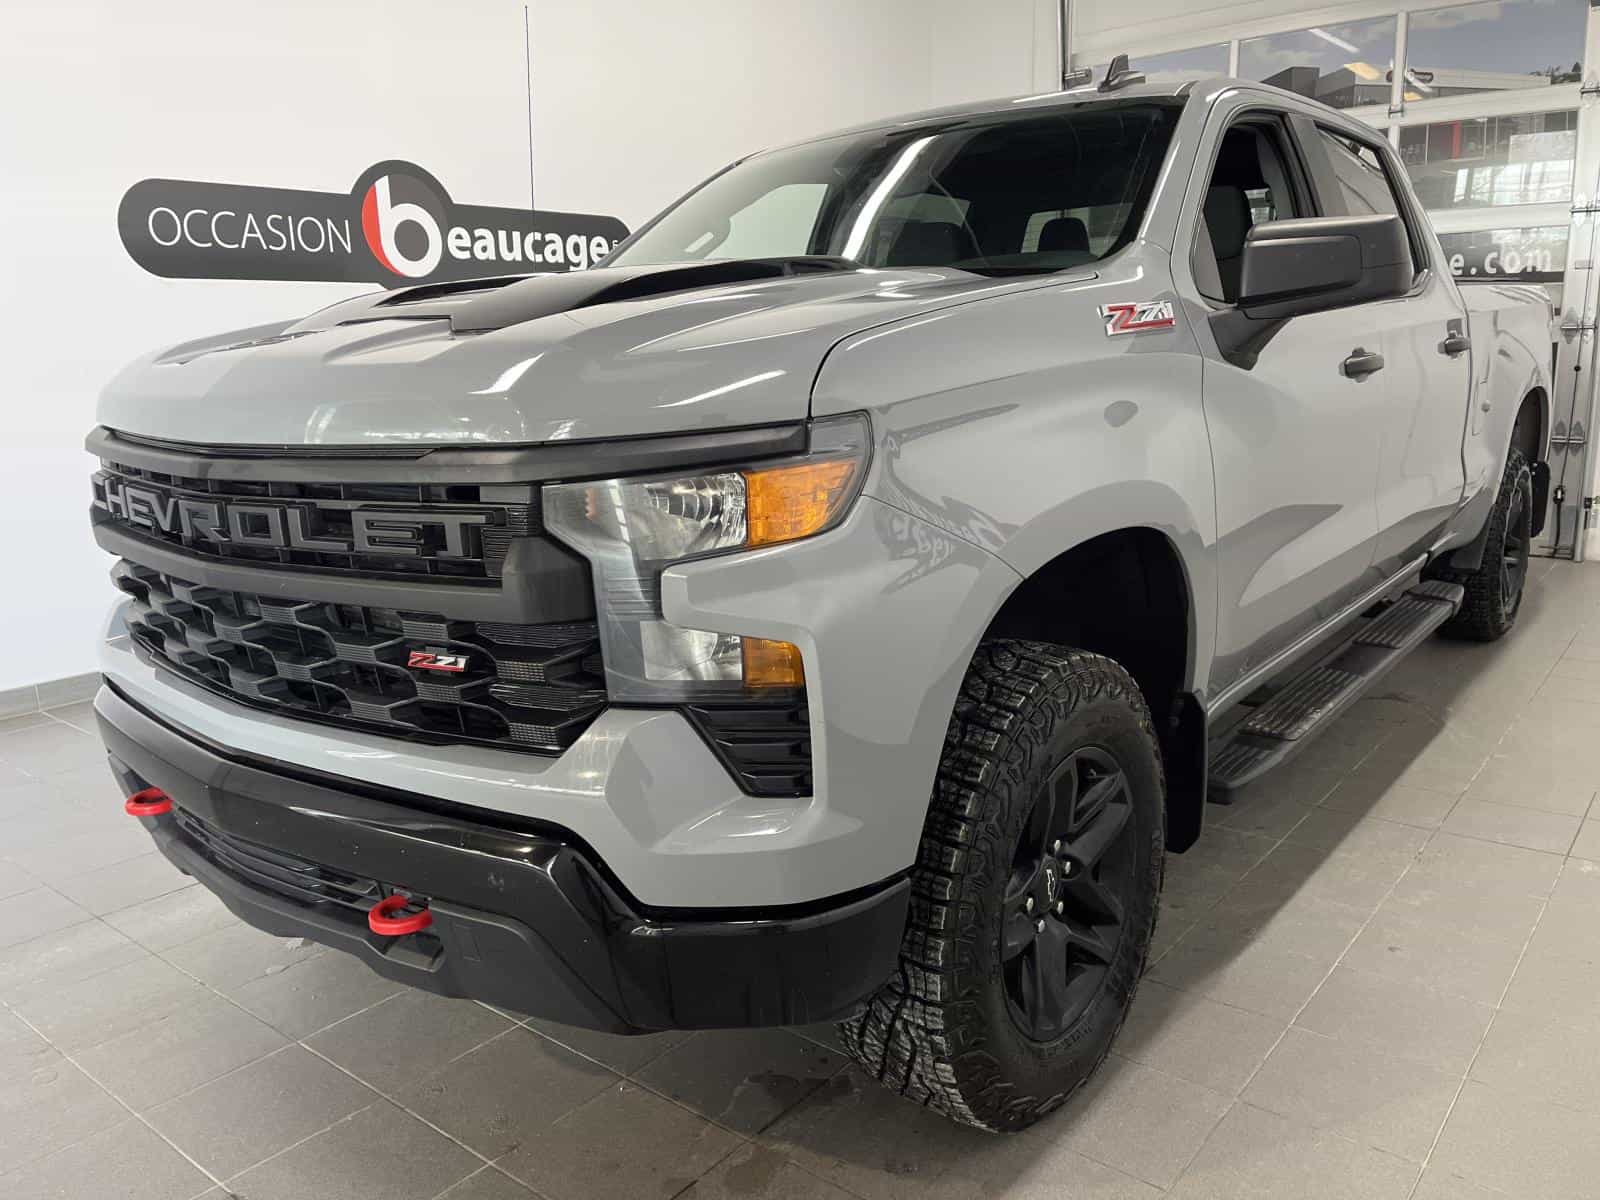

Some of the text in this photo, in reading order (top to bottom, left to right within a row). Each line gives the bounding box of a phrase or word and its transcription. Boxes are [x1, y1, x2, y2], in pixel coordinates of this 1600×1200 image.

[148, 206, 352, 254] OCCASION
[1097, 301, 1176, 336] Z71
[408, 651, 467, 673] Z71
